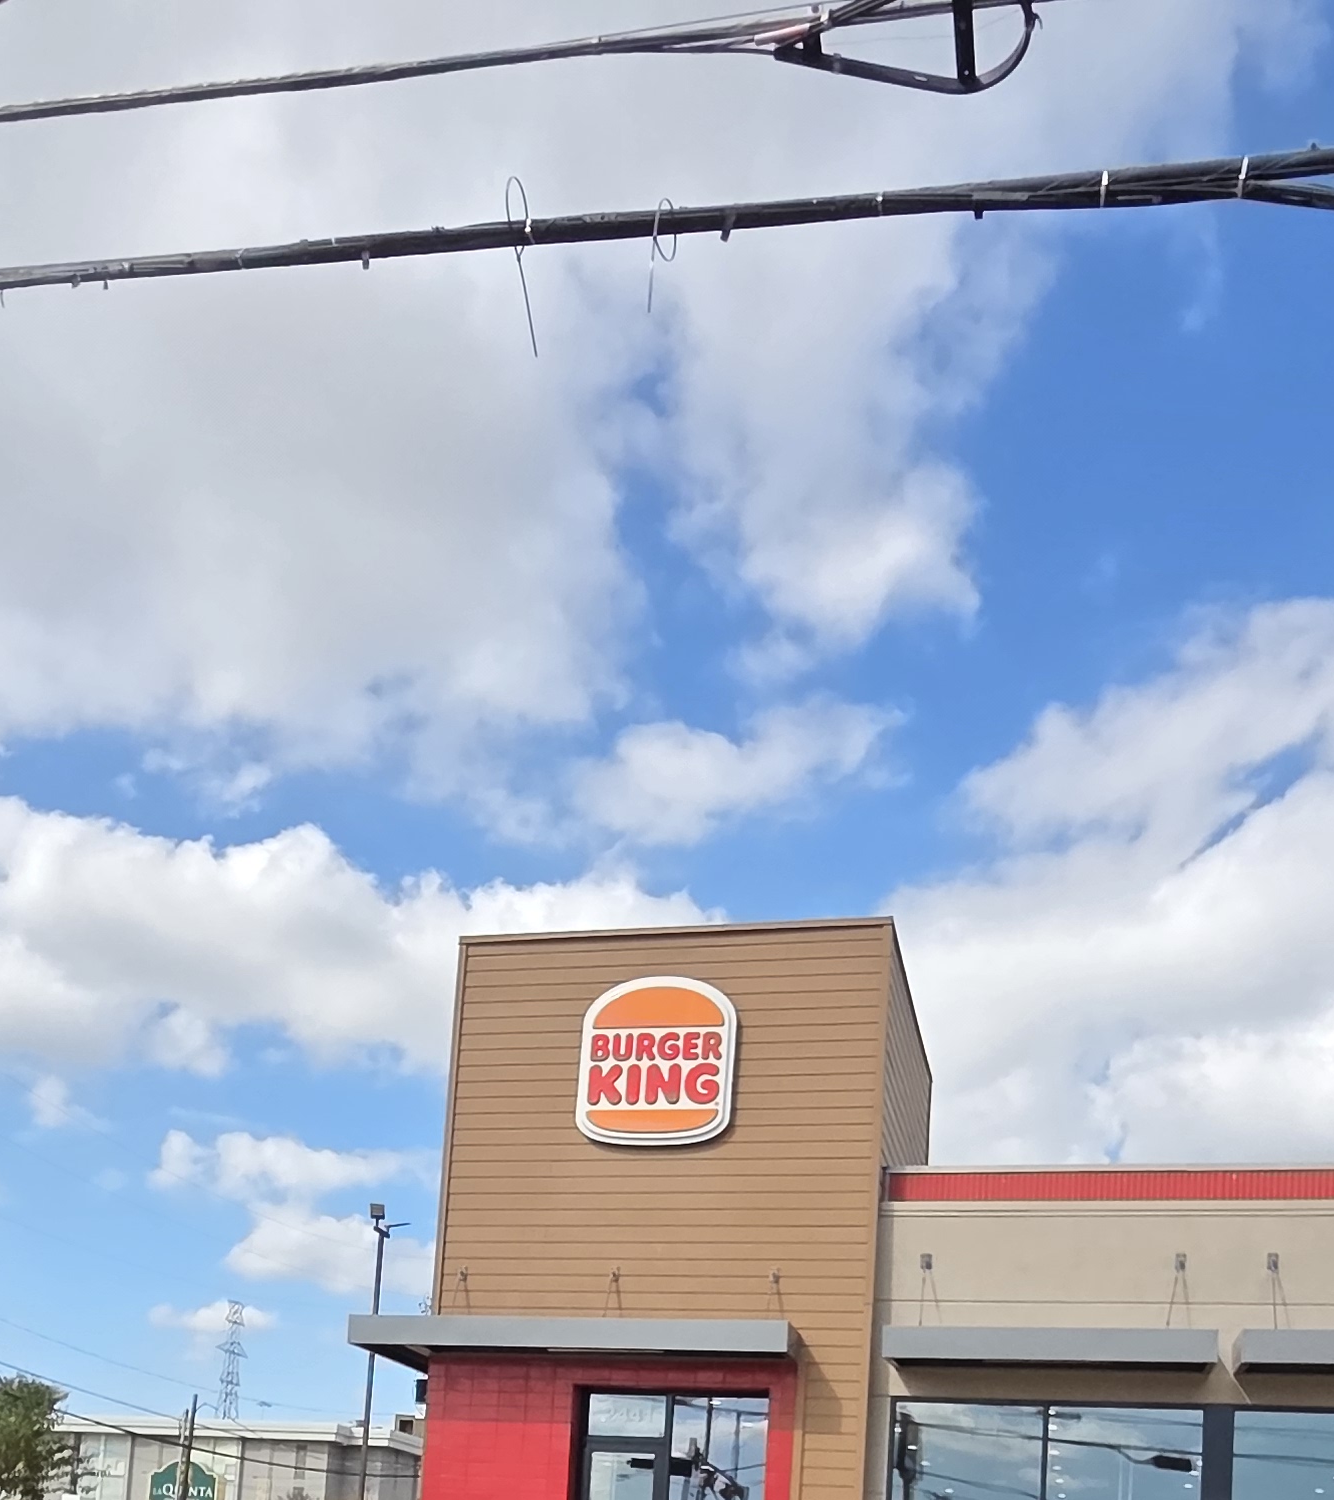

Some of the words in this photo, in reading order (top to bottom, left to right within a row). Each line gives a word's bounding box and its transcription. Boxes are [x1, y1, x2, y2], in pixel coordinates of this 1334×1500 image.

[590, 1031, 723, 1062] BURGER
[587, 1063, 720, 1106] KING
[152, 1487, 162, 1495] LA
